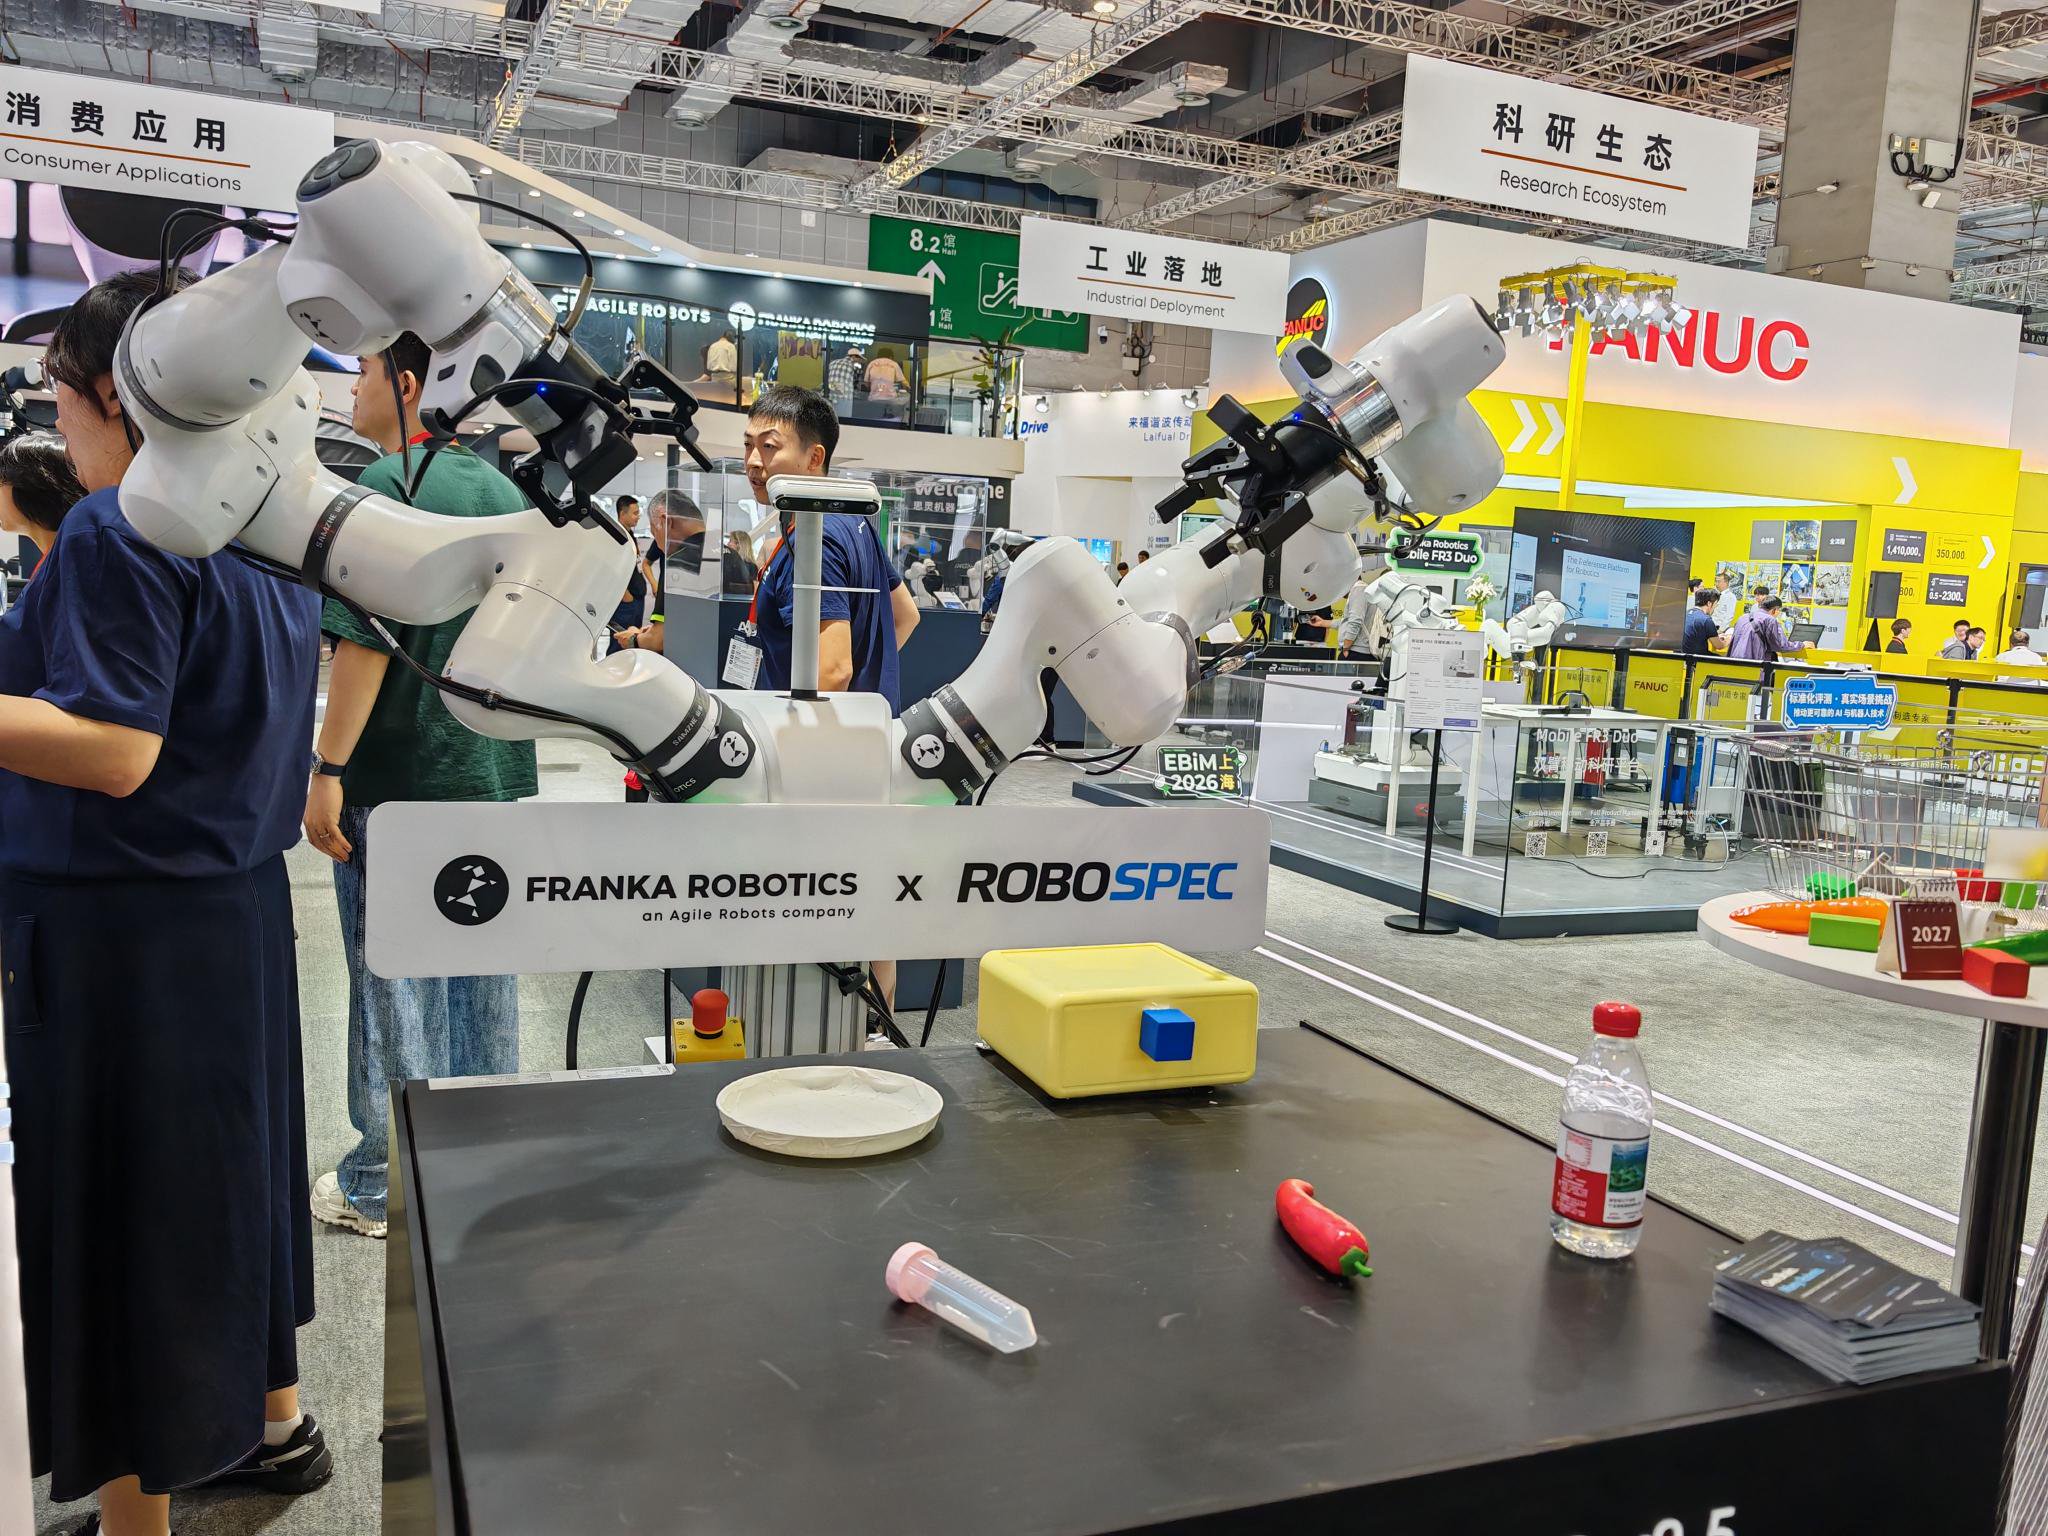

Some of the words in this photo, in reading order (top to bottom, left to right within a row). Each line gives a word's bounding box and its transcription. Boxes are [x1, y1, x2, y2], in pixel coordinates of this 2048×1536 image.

[5, 90, 226, 152] 消费应用
[1493, 103, 1673, 172] 科研生态
[4, 147, 112, 175] Consumer
[116, 162, 242, 191] Applications
[1499, 169, 1578, 200] Research
[1583, 185, 1668, 216] Ecosystem
[909, 228, 941, 254] 8.2
[941, 247, 957, 256] Hall
[1086, 245, 1223, 287] 工业落地
[588, 298, 639, 318] AGILE
[1086, 289, 1147, 309] Industrial
[1150, 297, 1226, 318] Deployment
[938, 321, 953, 331] Hall
[1282, 315, 1325, 336] FANUC
[1548, 296, 1810, 381] ANUC
[1020, 420, 1049, 434] Drive
[1143, 431, 1176, 442] Laifual
[913, 501, 957, 514] 思灵机器
[1432, 539, 1469, 550] Robotics
[1431, 550, 1452, 562] FR3
[1454, 552, 1478, 564] Duo
[1634, 680, 1669, 693] FANUC
[1789, 693, 1833, 705] 标准化评测
[1841, 693, 1893, 705] 真实场景挑战
[1843, 709, 1885, 718] 与机器人技术
[1585, 728, 1609, 743] FR3
[1612, 729, 1639, 743] Duo
[1164, 752, 1217, 771] EBiM
[1171, 773, 1219, 790] 2026
[526, 874, 677, 902] FRANKA
[687, 872, 858, 898] ROBOTICS
[957, 861, 1238, 903] ROBOSPEC
[642, 912, 663, 922] an
[670, 909, 713, 923] Agile
[719, 908, 777, 920] Robots
[782, 906, 856, 921] company
[1911, 926, 1951, 943] 2027
